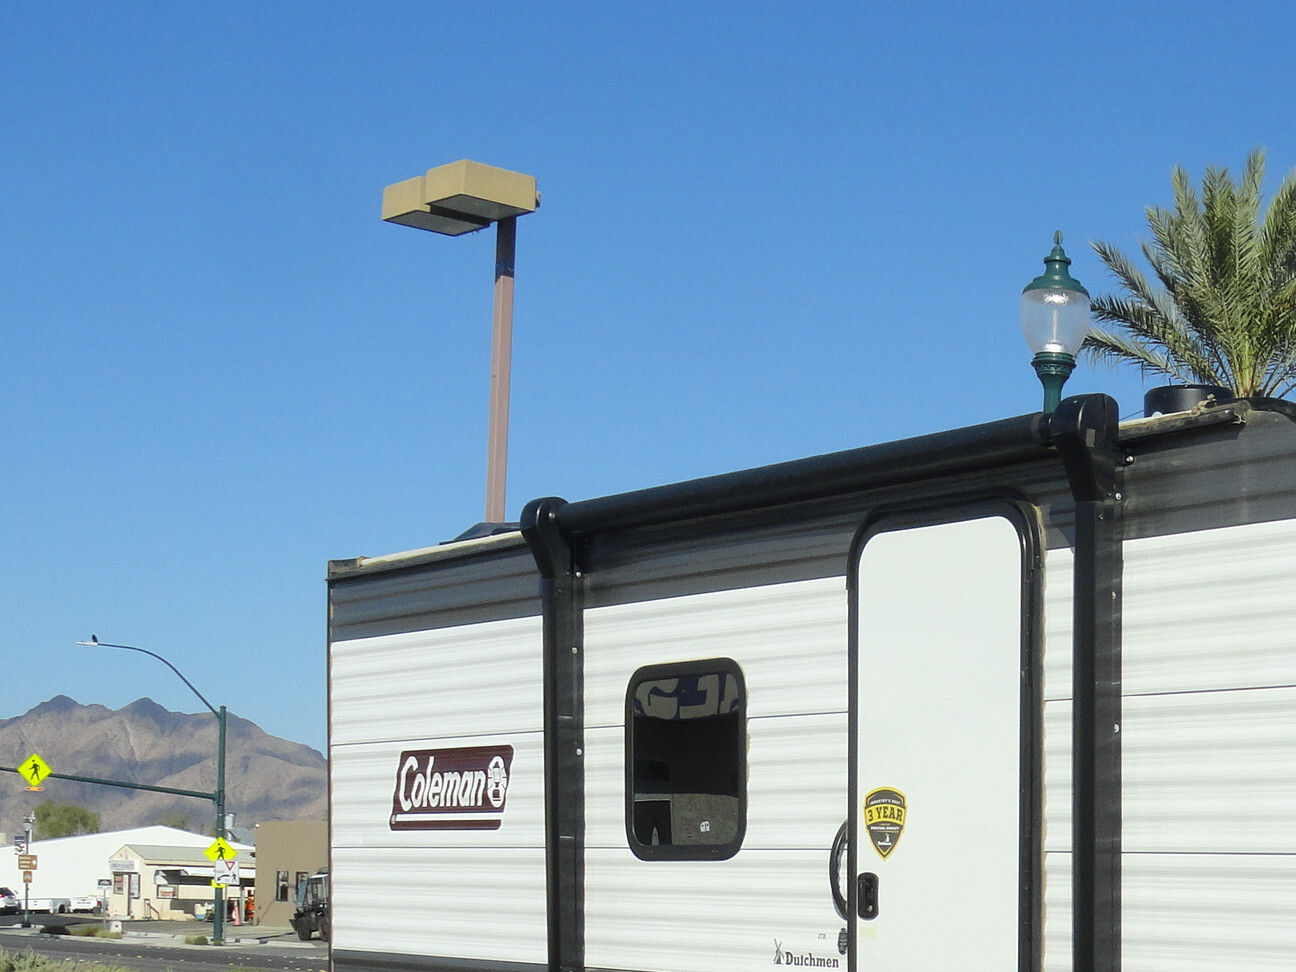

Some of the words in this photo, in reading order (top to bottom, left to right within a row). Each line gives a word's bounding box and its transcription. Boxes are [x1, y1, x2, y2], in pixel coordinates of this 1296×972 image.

[399, 756, 486, 811] Coleman
[867, 809, 874, 822] 3
[876, 806, 903, 822] YEAR
[784, 951, 840, 969] Dutchmen
